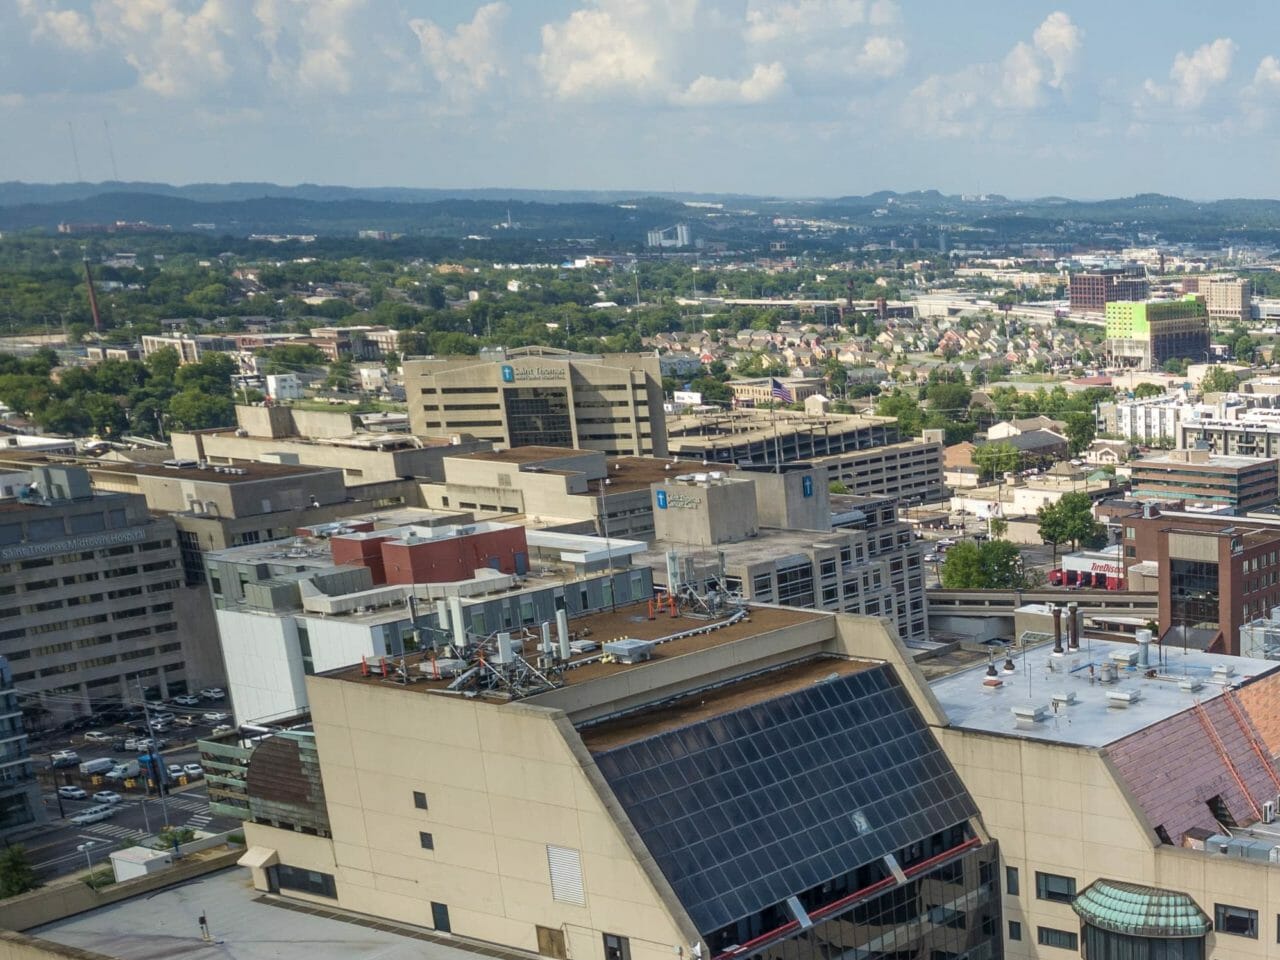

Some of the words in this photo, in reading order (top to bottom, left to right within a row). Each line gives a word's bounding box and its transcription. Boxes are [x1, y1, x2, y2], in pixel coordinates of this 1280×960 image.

[2, 547, 28, 559] Saint
[28, 542, 67, 555] Thomas
[67, 535, 108, 550] Midtown
[110, 528, 146, 545] Hospital
